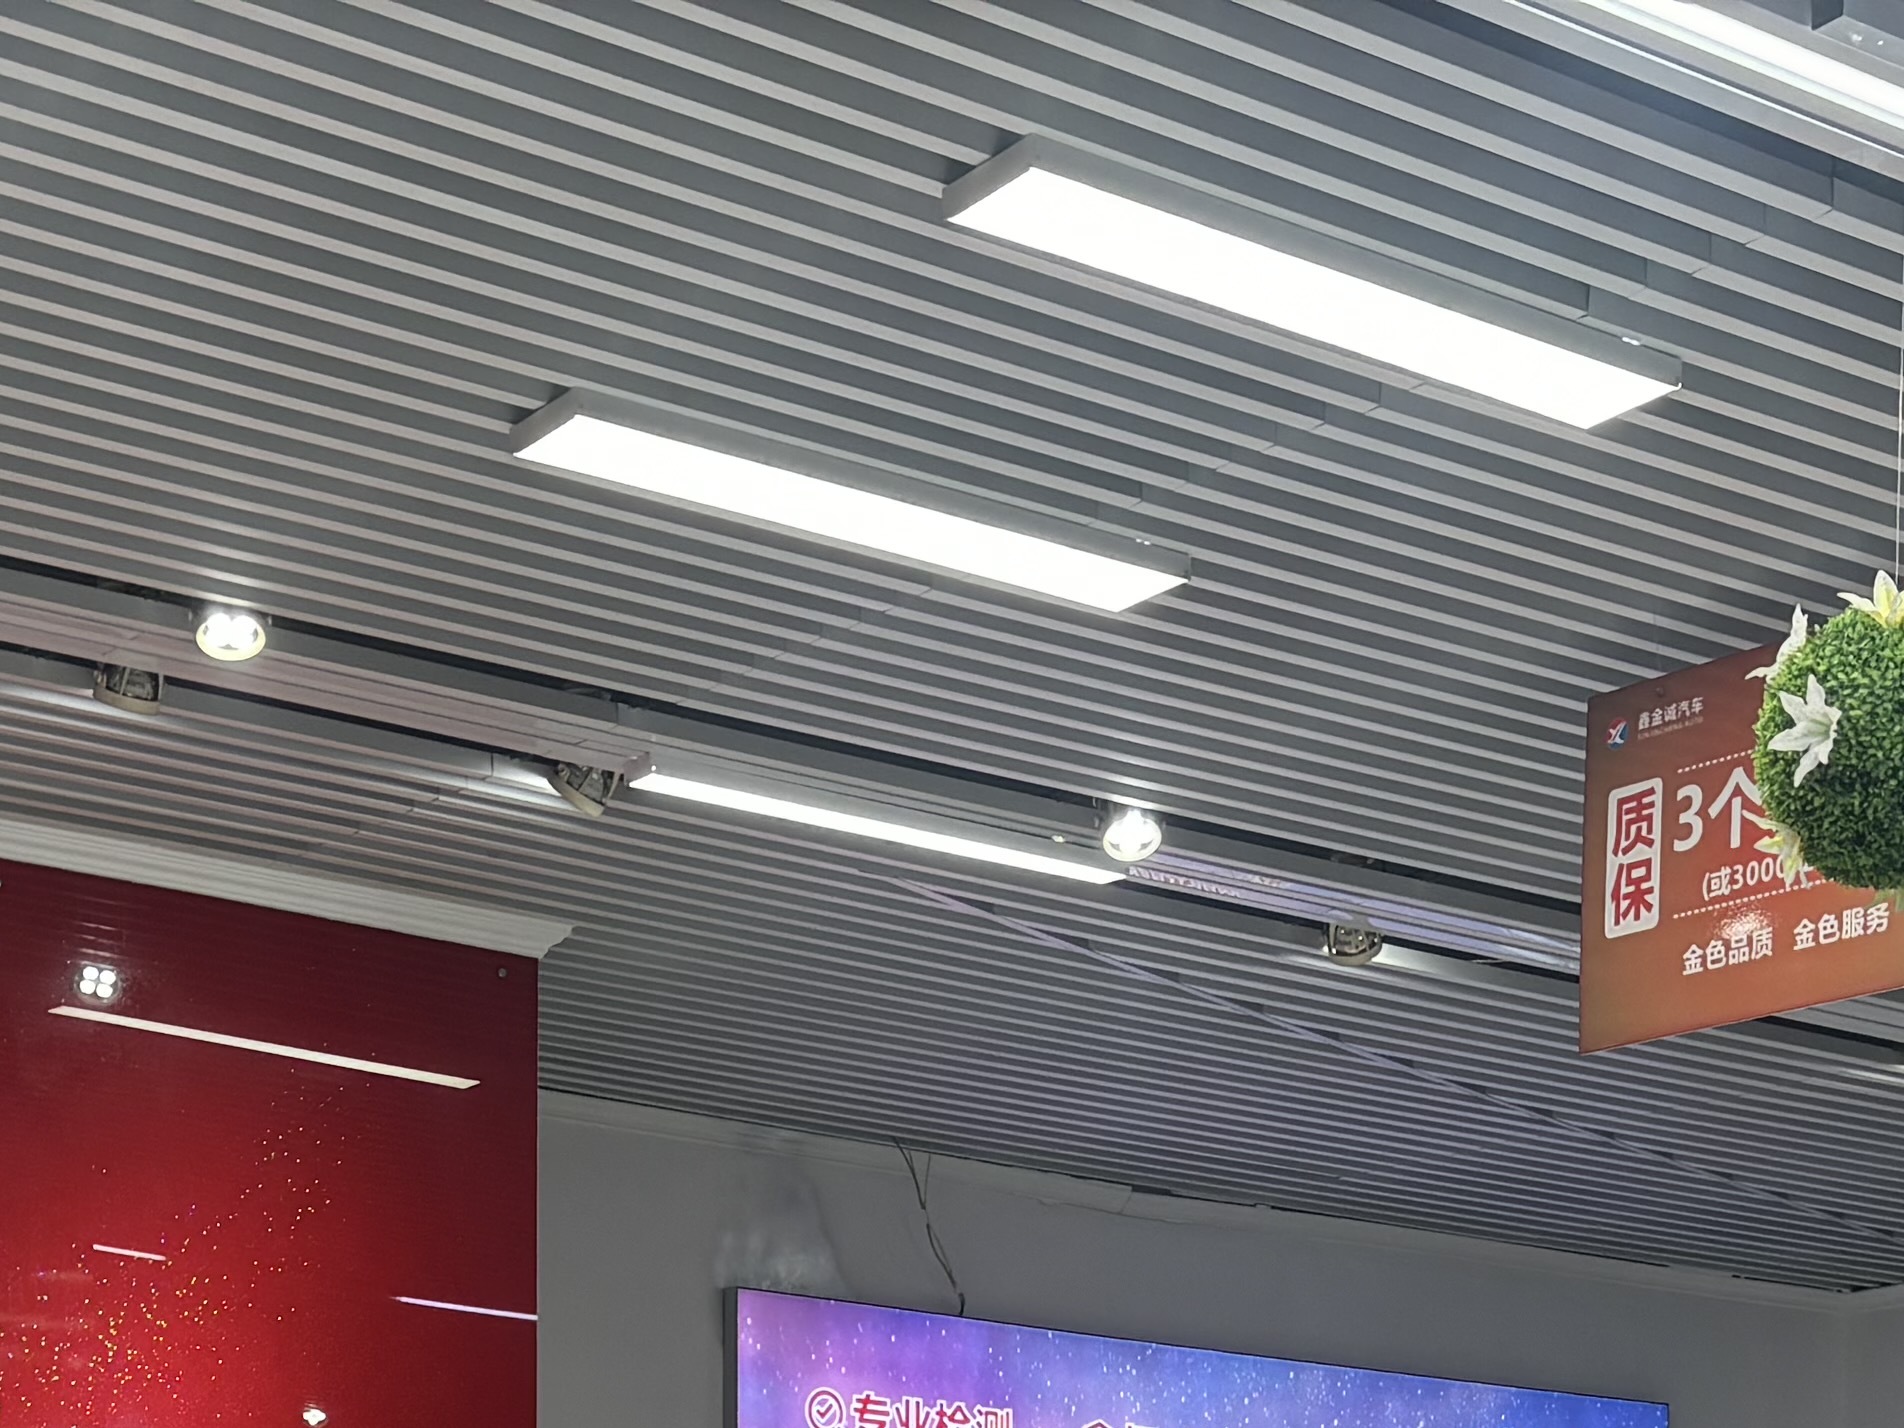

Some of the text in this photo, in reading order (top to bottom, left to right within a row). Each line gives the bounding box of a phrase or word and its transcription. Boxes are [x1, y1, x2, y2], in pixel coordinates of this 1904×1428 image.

[1609, 785, 1661, 927] 质保
[1681, 901, 1891, 976] 金色品质 金色服务
